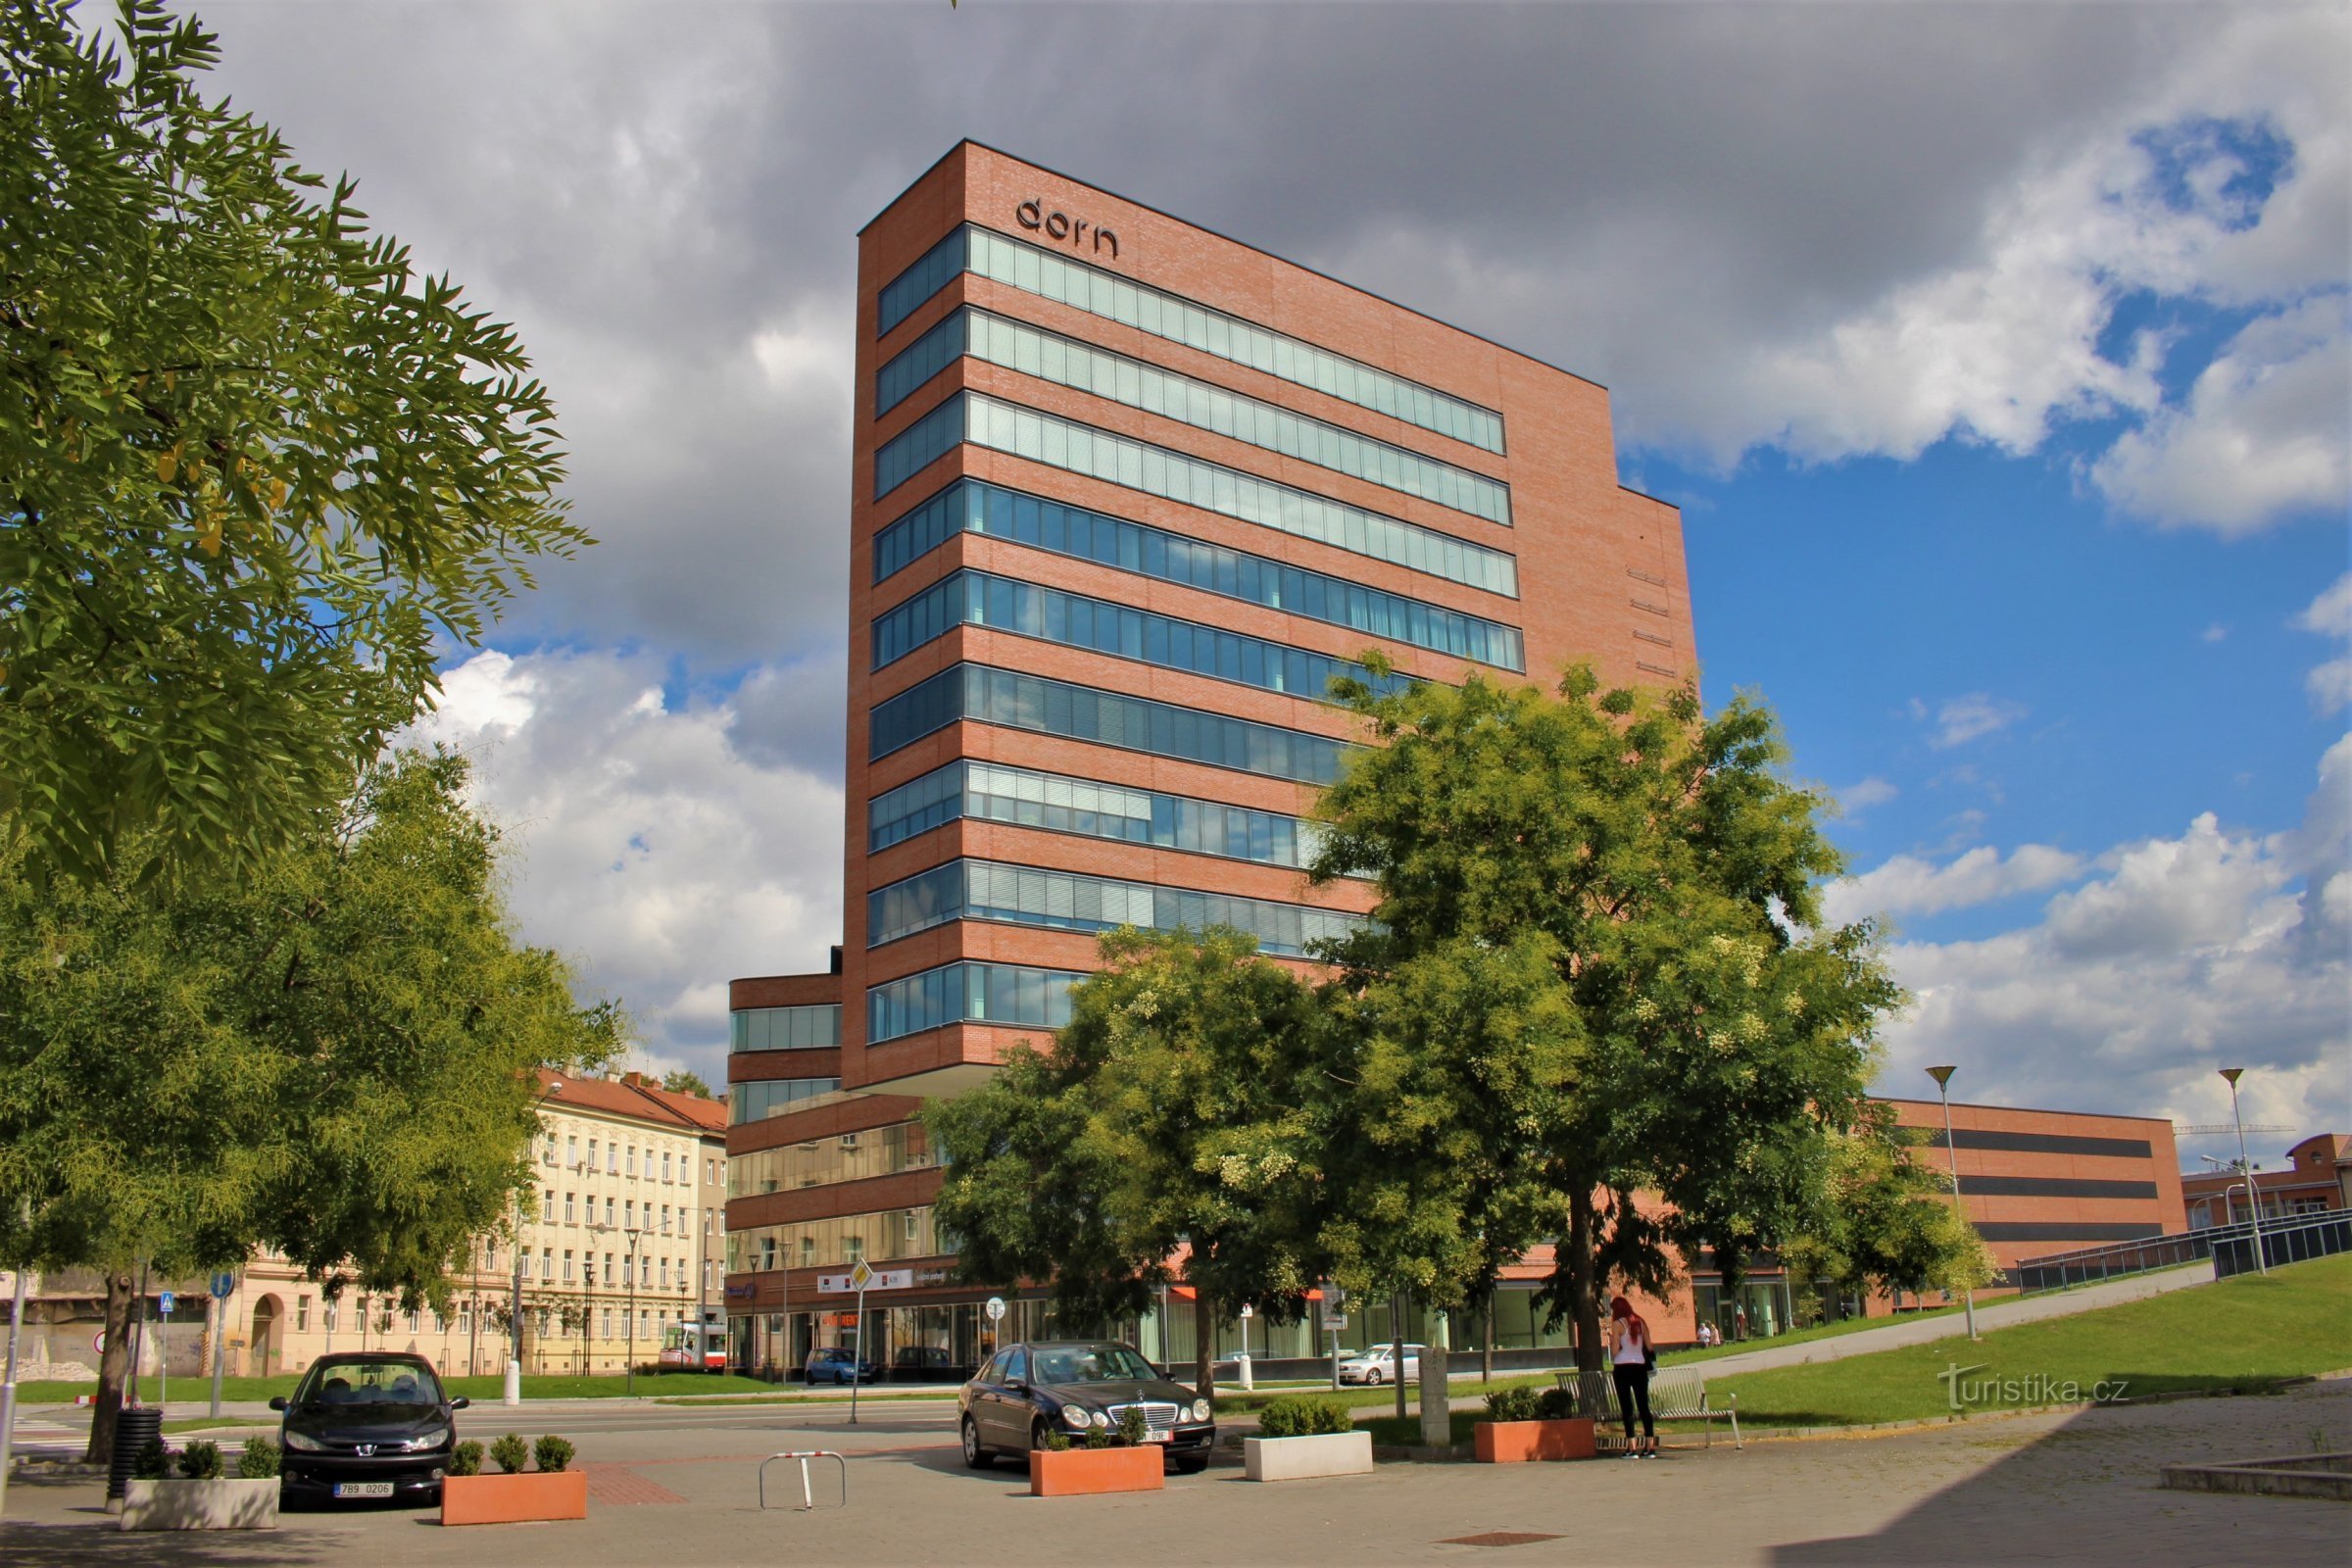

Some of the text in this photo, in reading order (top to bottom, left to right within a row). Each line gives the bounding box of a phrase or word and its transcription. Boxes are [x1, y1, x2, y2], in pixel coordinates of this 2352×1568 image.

[1016, 197, 1119, 261] dorn
[342, 1485, 389, 1494] 7B9 0206
